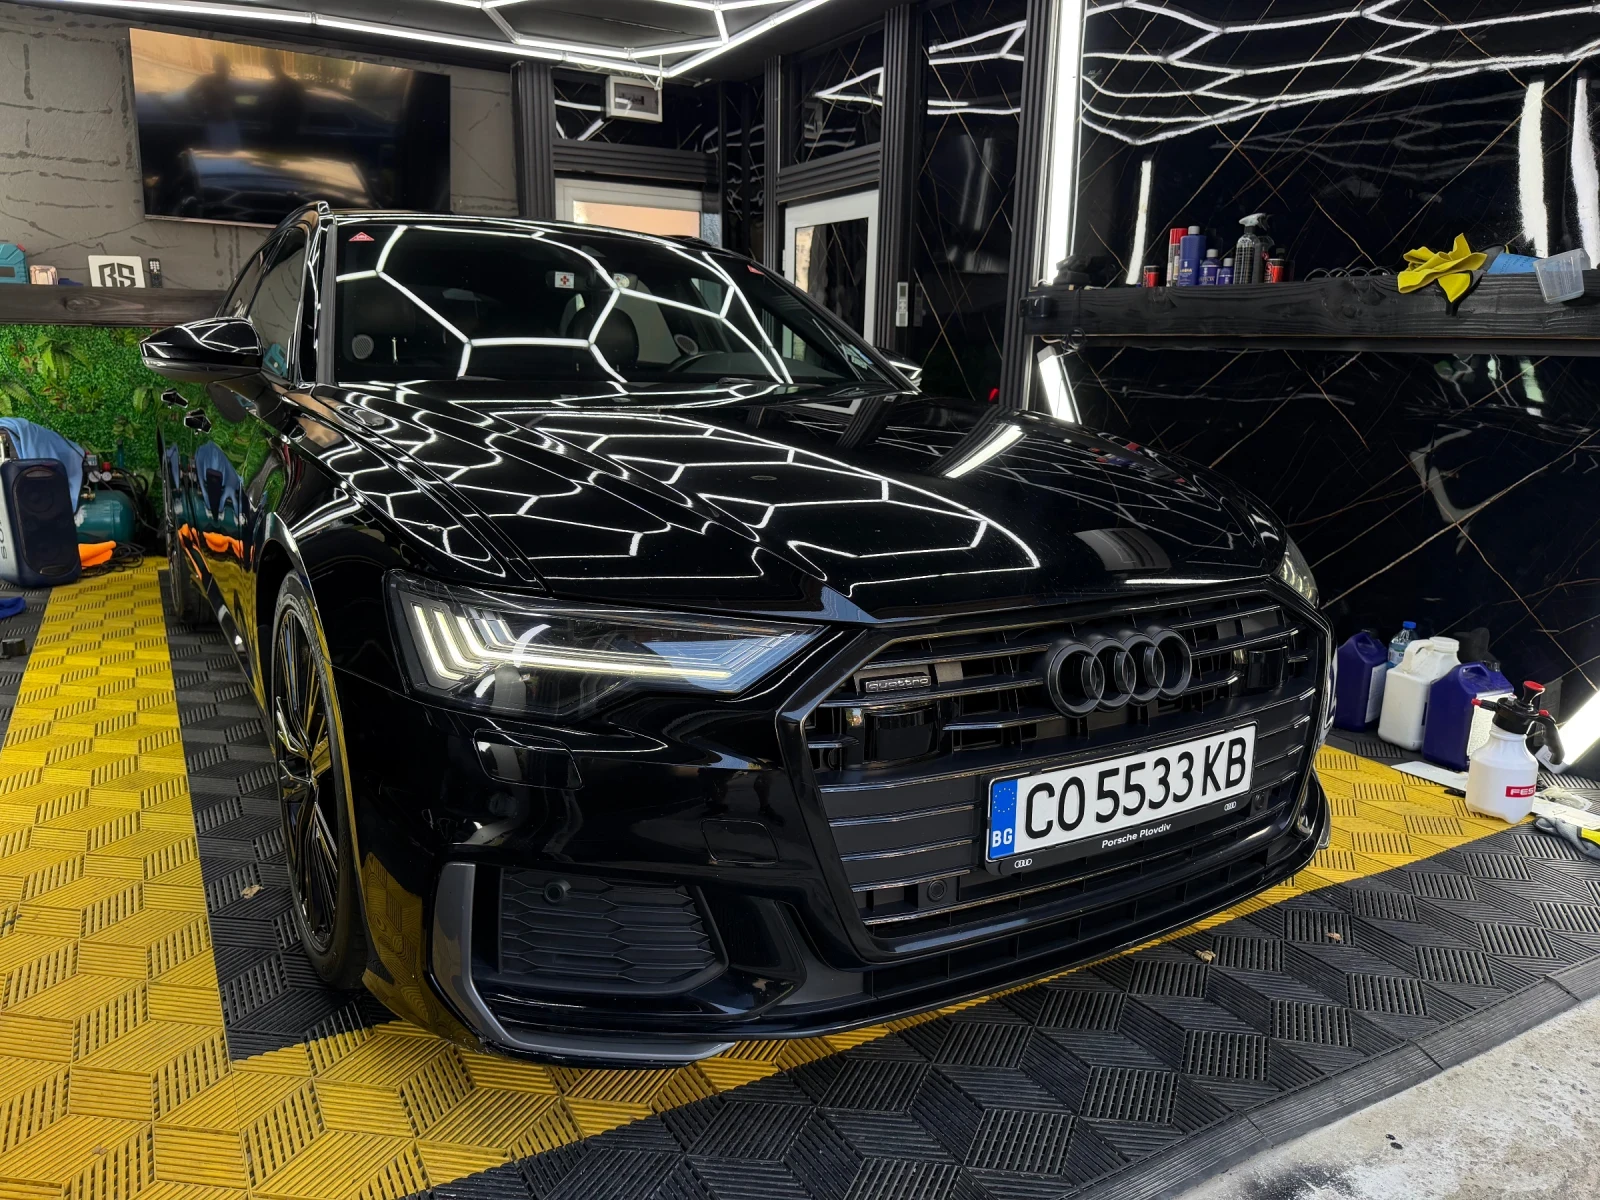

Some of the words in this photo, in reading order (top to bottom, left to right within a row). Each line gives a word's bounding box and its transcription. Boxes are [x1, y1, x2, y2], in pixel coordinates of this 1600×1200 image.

[868, 677, 930, 692] quattro
[1095, 751, 1195, 823] 5533
[1201, 736, 1247, 797] KB
[991, 827, 1013, 849] BG
[1101, 833, 1138, 849] Porsche
[1139, 823, 1172, 838] Plovdiv
